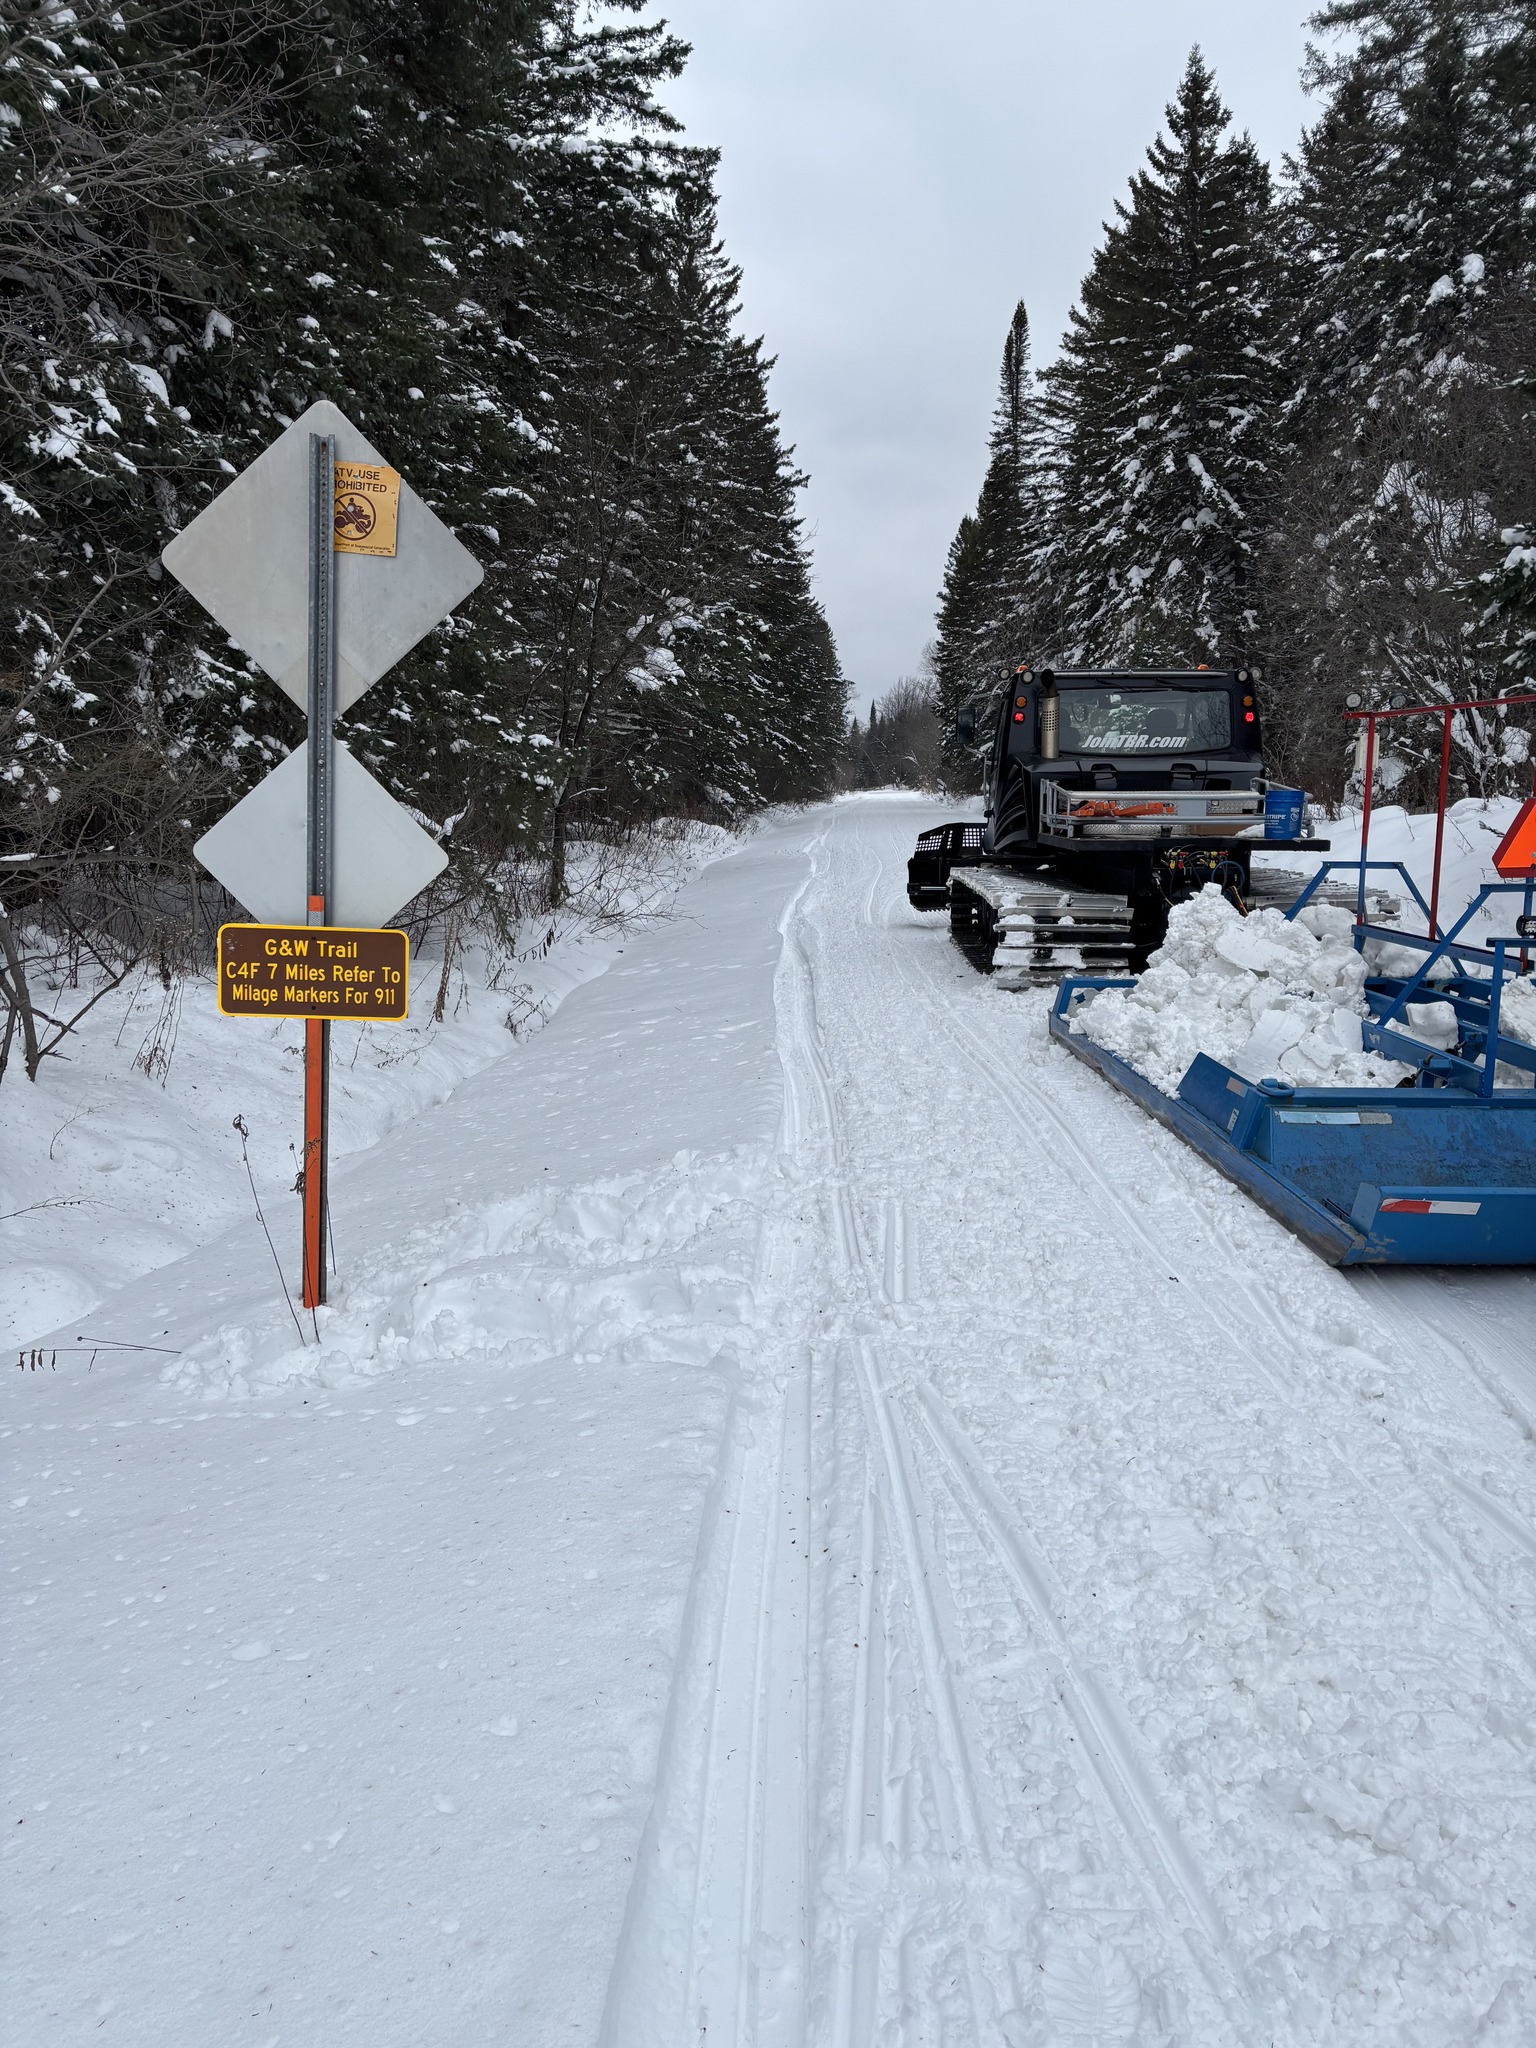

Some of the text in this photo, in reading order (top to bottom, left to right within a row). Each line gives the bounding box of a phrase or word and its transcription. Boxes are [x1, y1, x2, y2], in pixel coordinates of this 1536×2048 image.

[334, 467, 380, 480] ATV USE
[334, 480, 387, 492] OHIBITED
[1081, 734, 1188, 749] JoinTBR.com
[264, 938, 358, 959] G&W Trail
[226, 961, 401, 984] C4F 7 Miles Refer To
[232, 984, 395, 1007] Milage Markers For 911
